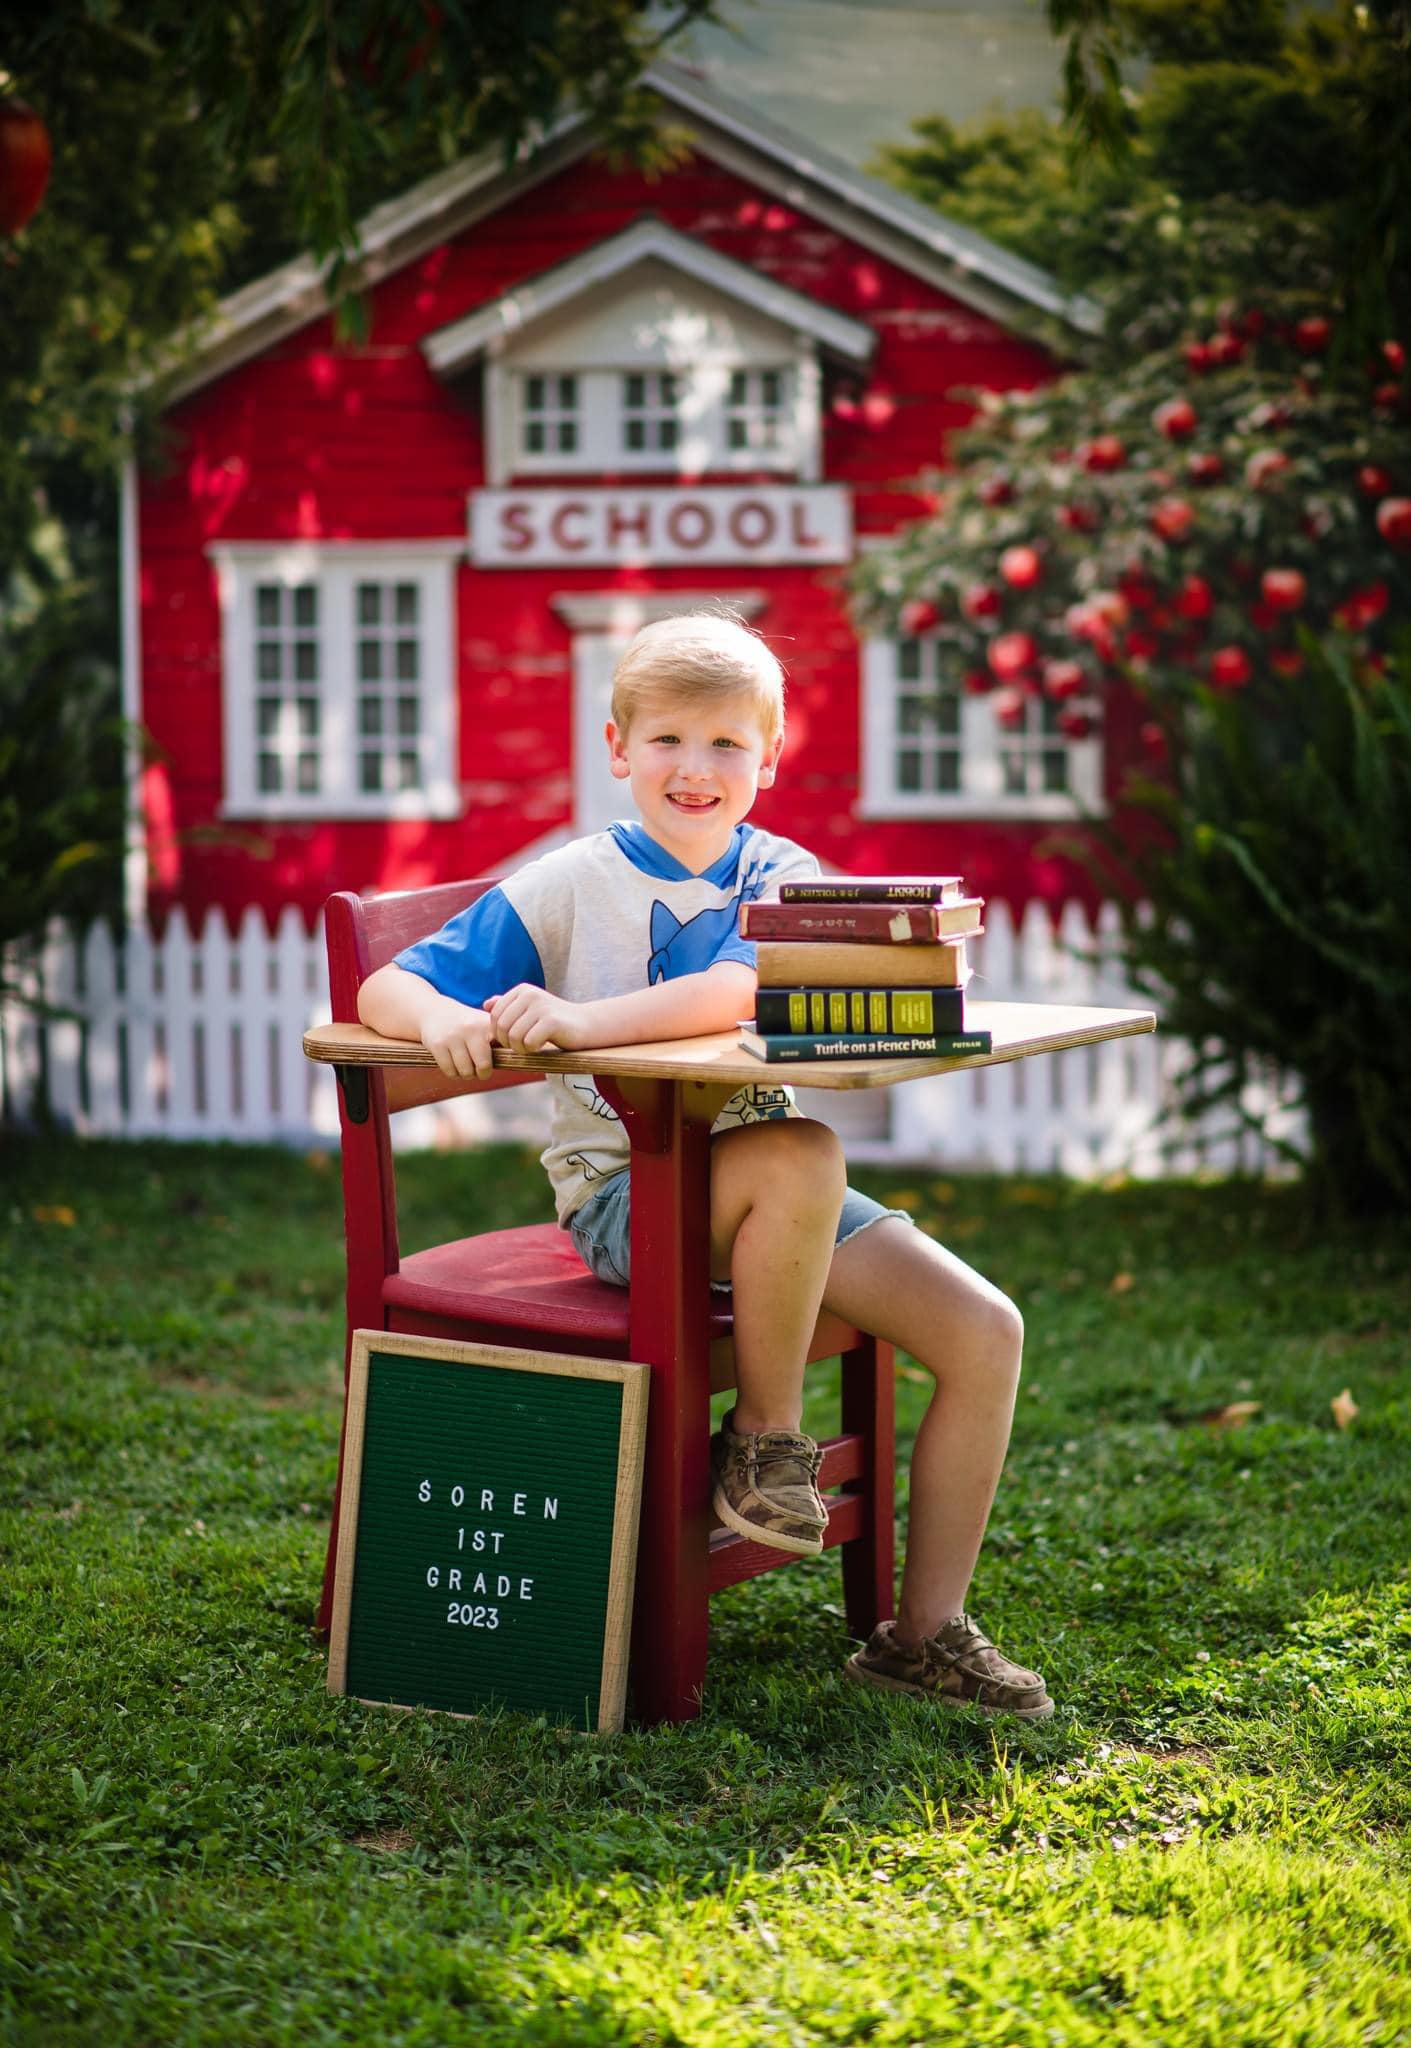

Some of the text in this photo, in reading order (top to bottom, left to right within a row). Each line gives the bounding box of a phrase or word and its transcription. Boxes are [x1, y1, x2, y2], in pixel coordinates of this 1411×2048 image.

[500, 502, 825, 551] SCHOOL
[814, 1040, 849, 1055] Turtle
[851, 1043, 866, 1052] on
[868, 1043, 876, 1052] a
[877, 1040, 909, 1052] Fence
[911, 1038, 936, 1050] Post
[418, 1480, 558, 1520] SOREN
[458, 1527, 505, 1554] 1ST
[427, 1566, 534, 1600] GRADE
[447, 1603, 499, 1630] 2023
